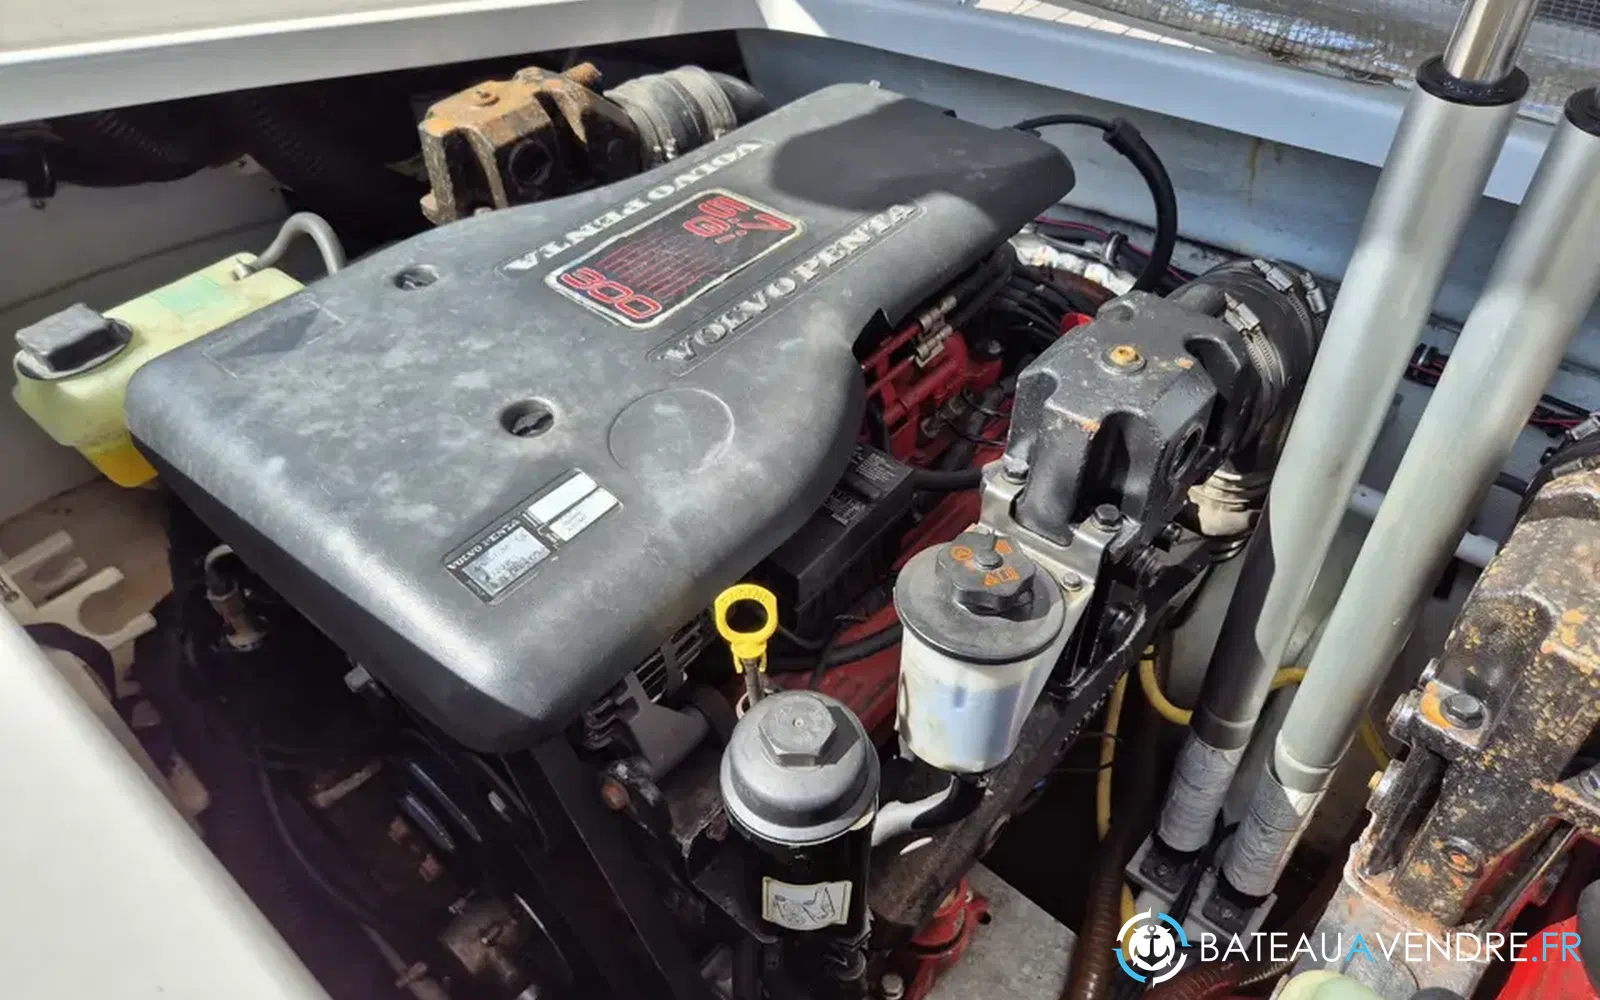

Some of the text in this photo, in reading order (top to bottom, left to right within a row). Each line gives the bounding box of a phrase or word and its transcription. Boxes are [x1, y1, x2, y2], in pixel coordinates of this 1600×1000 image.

[503, 142, 763, 271] VOLVO PENTA
[697, 195, 793, 231] 5.7
[561, 266, 663, 320] 300
[662, 203, 916, 363] VOLVO PENTA
[446, 544, 483, 570] VOLVO
[482, 518, 521, 547] PENTA
